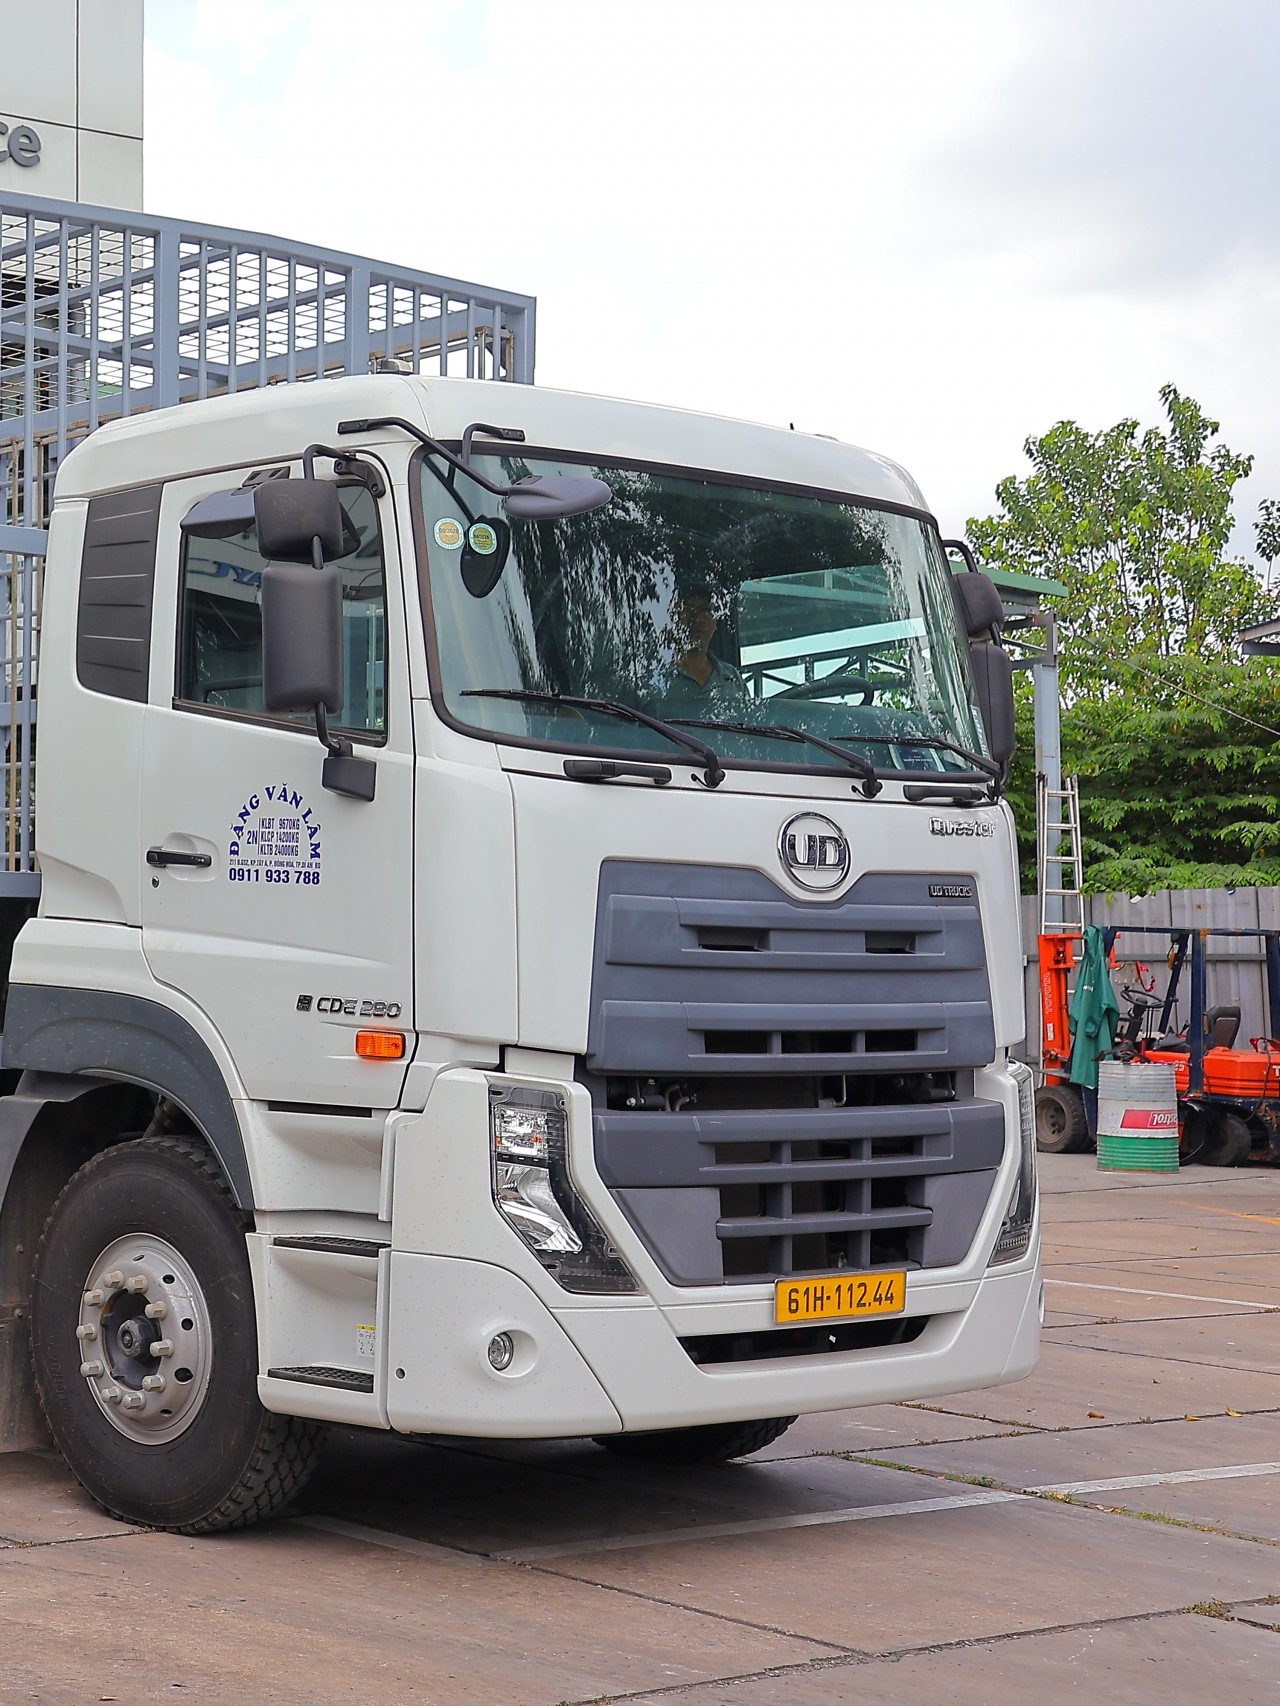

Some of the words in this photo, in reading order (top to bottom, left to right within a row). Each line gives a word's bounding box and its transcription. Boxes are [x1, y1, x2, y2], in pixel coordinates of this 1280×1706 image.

[261, 818, 275, 829] KLBT
[265, 783, 303, 809] VĂN
[301, 807, 321, 860] LÂM
[929, 817, 996, 837] Quester
[246, 830, 258, 845] 2N
[260, 844, 273, 856] KLTB
[785, 834, 847, 871] UD
[229, 868, 259, 882] 0911
[265, 869, 290, 883] 933
[294, 870, 320, 885] 788
[931, 885, 943, 897] UD
[943, 885, 972, 898] TRUCKS
[317, 996, 358, 1016] CDE
[359, 1000, 402, 1019] 280
[788, 1280, 895, 1314] 61H-112.44
